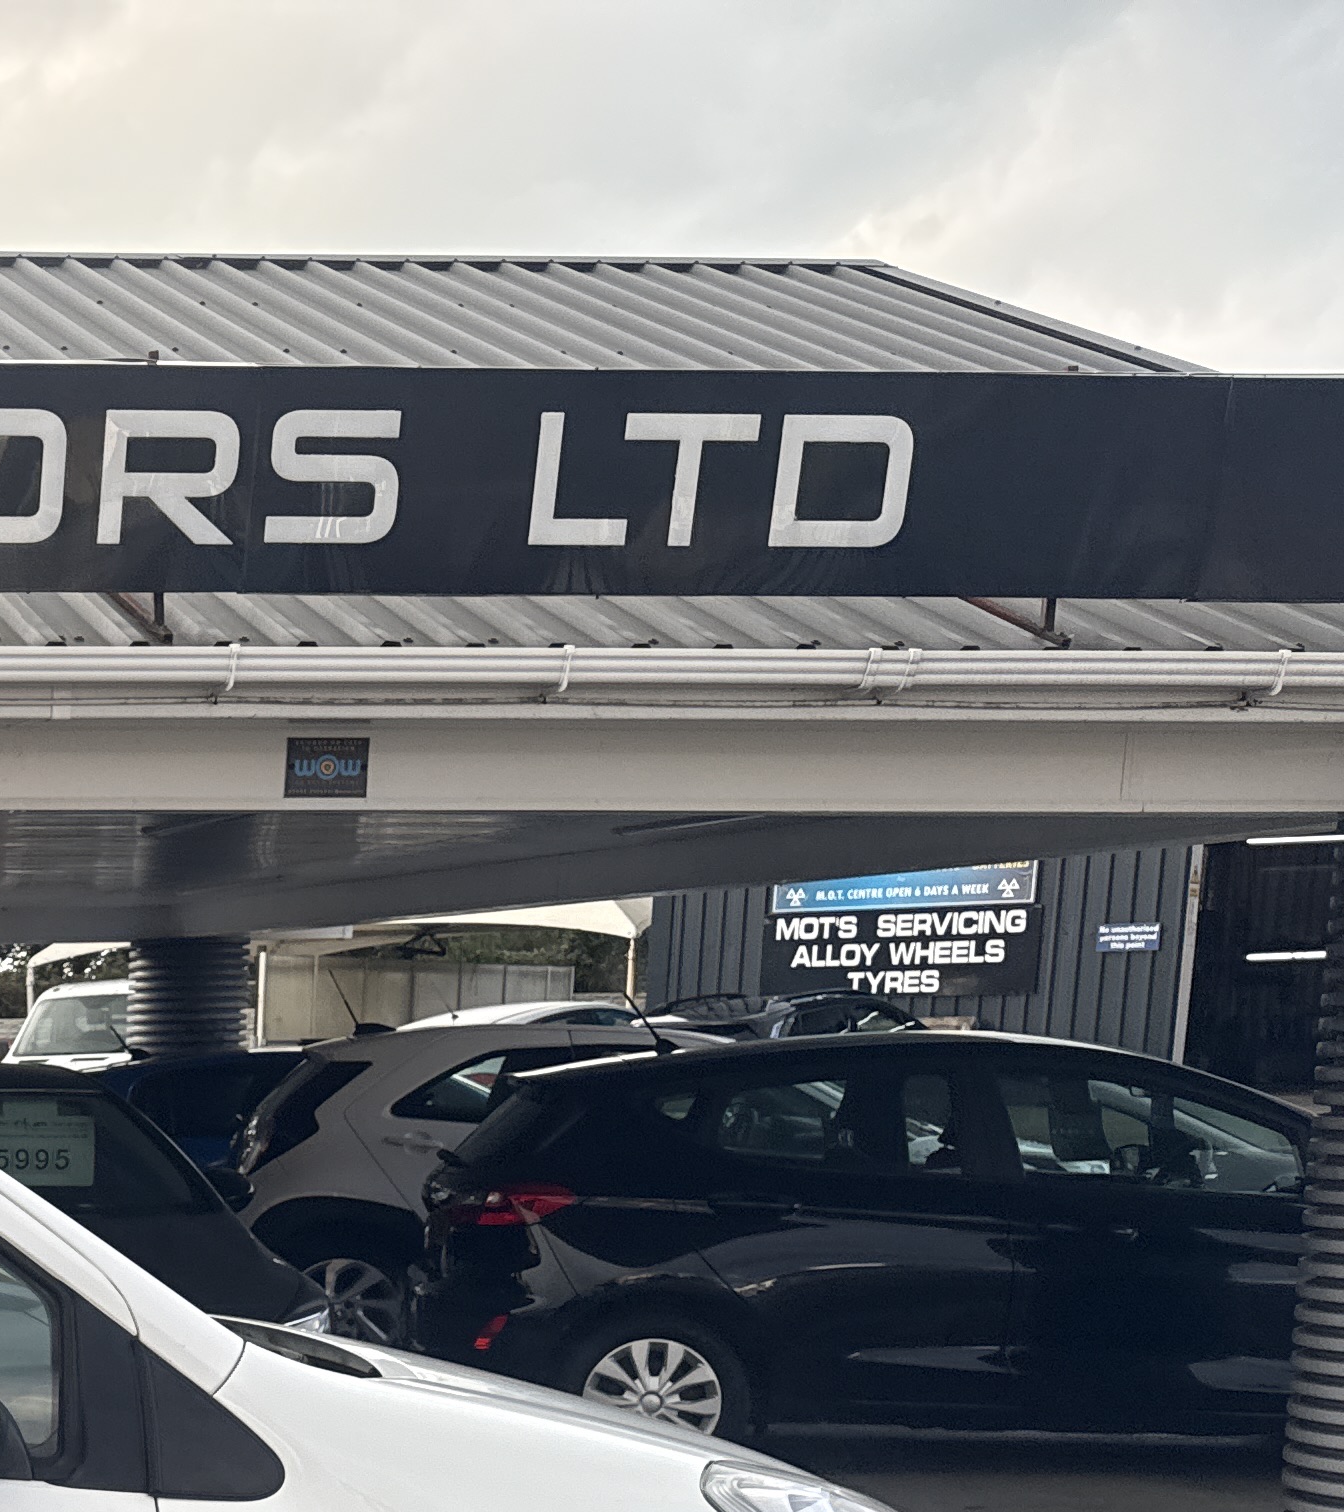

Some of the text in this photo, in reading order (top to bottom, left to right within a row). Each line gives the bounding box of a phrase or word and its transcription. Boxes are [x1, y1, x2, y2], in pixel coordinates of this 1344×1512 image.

[527, 411, 914, 547] LTD
[815, 883, 990, 901] M.O.T. CENTRE OPEN 6 DAYS A WEEK
[775, 909, 1027, 941] MOT'S SERVICING
[790, 939, 1006, 969] ALLOY WHEELS
[847, 969, 940, 995] TYRES
